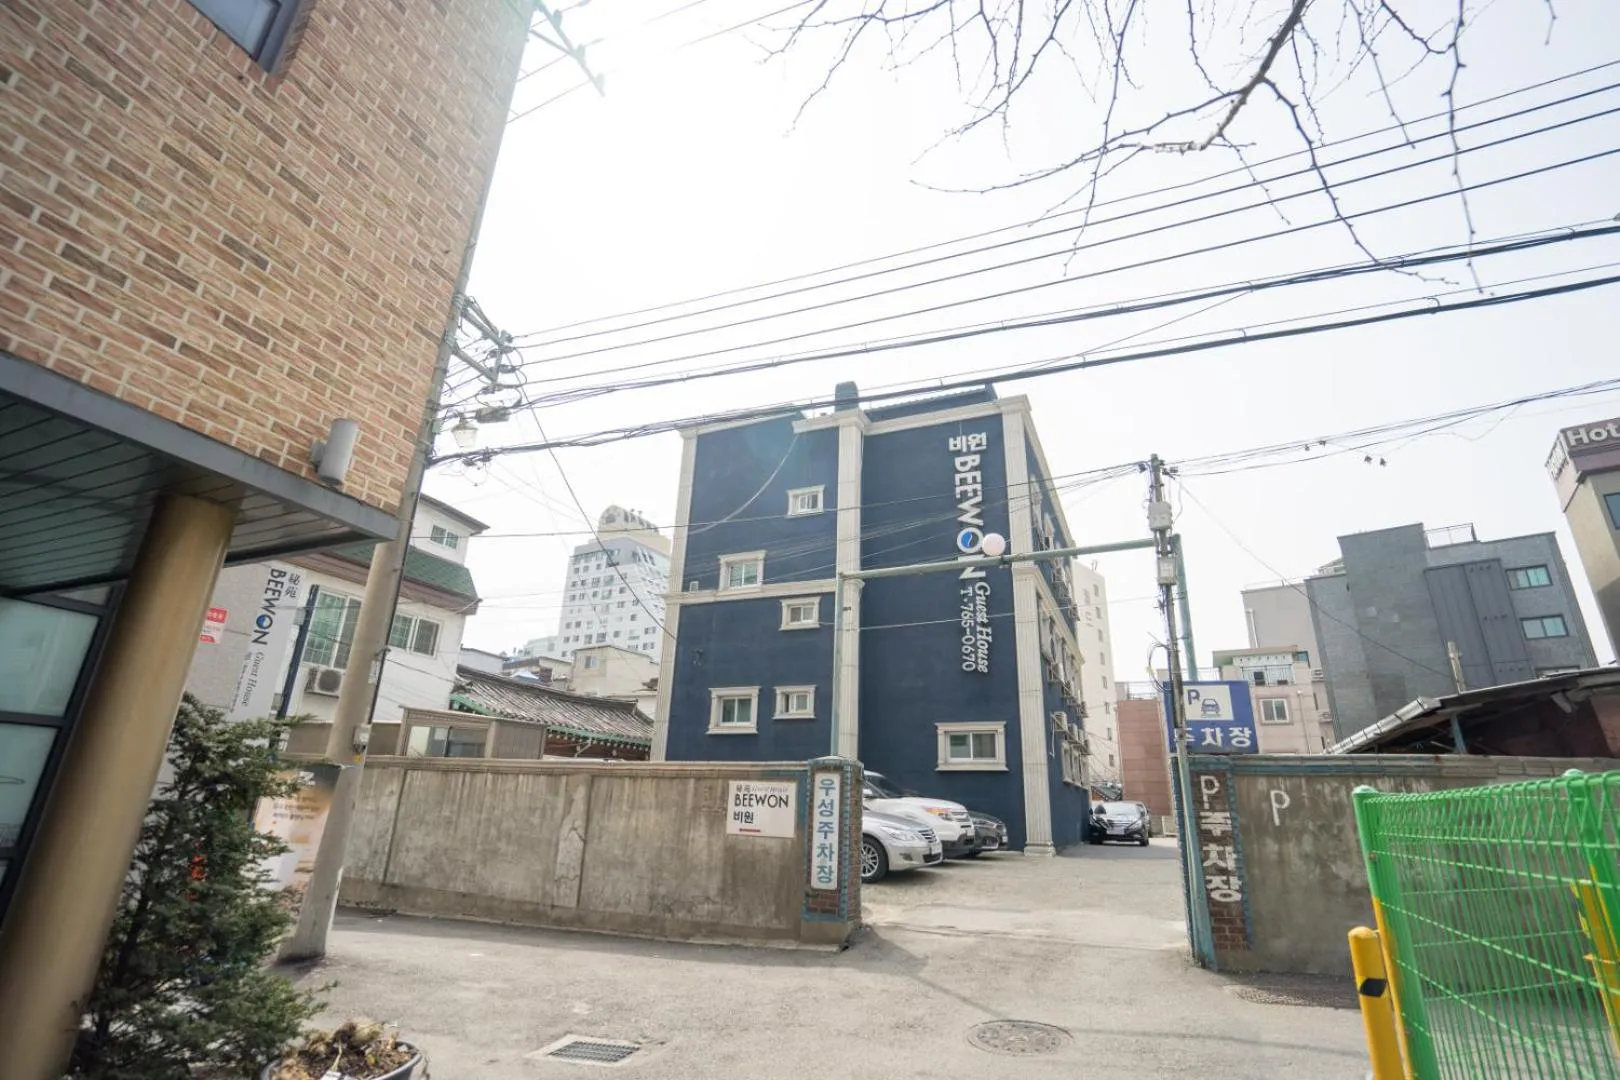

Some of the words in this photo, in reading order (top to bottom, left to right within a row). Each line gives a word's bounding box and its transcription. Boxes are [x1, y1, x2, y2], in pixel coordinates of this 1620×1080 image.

[948, 432, 987, 452] 비원
[954, 453, 986, 580] BEEWON
[251, 568, 287, 646] BEEWON
[974, 581, 991, 624] Guest
[976, 625, 993, 673] House
[1187, 689, 1200, 705] P
[733, 810, 754, 824] 비원
[734, 793, 789, 808] BEEWON
[1269, 789, 1290, 826] P
[816, 778, 836, 884] 우성주차장
[1200, 811, 1243, 902] 주차장
